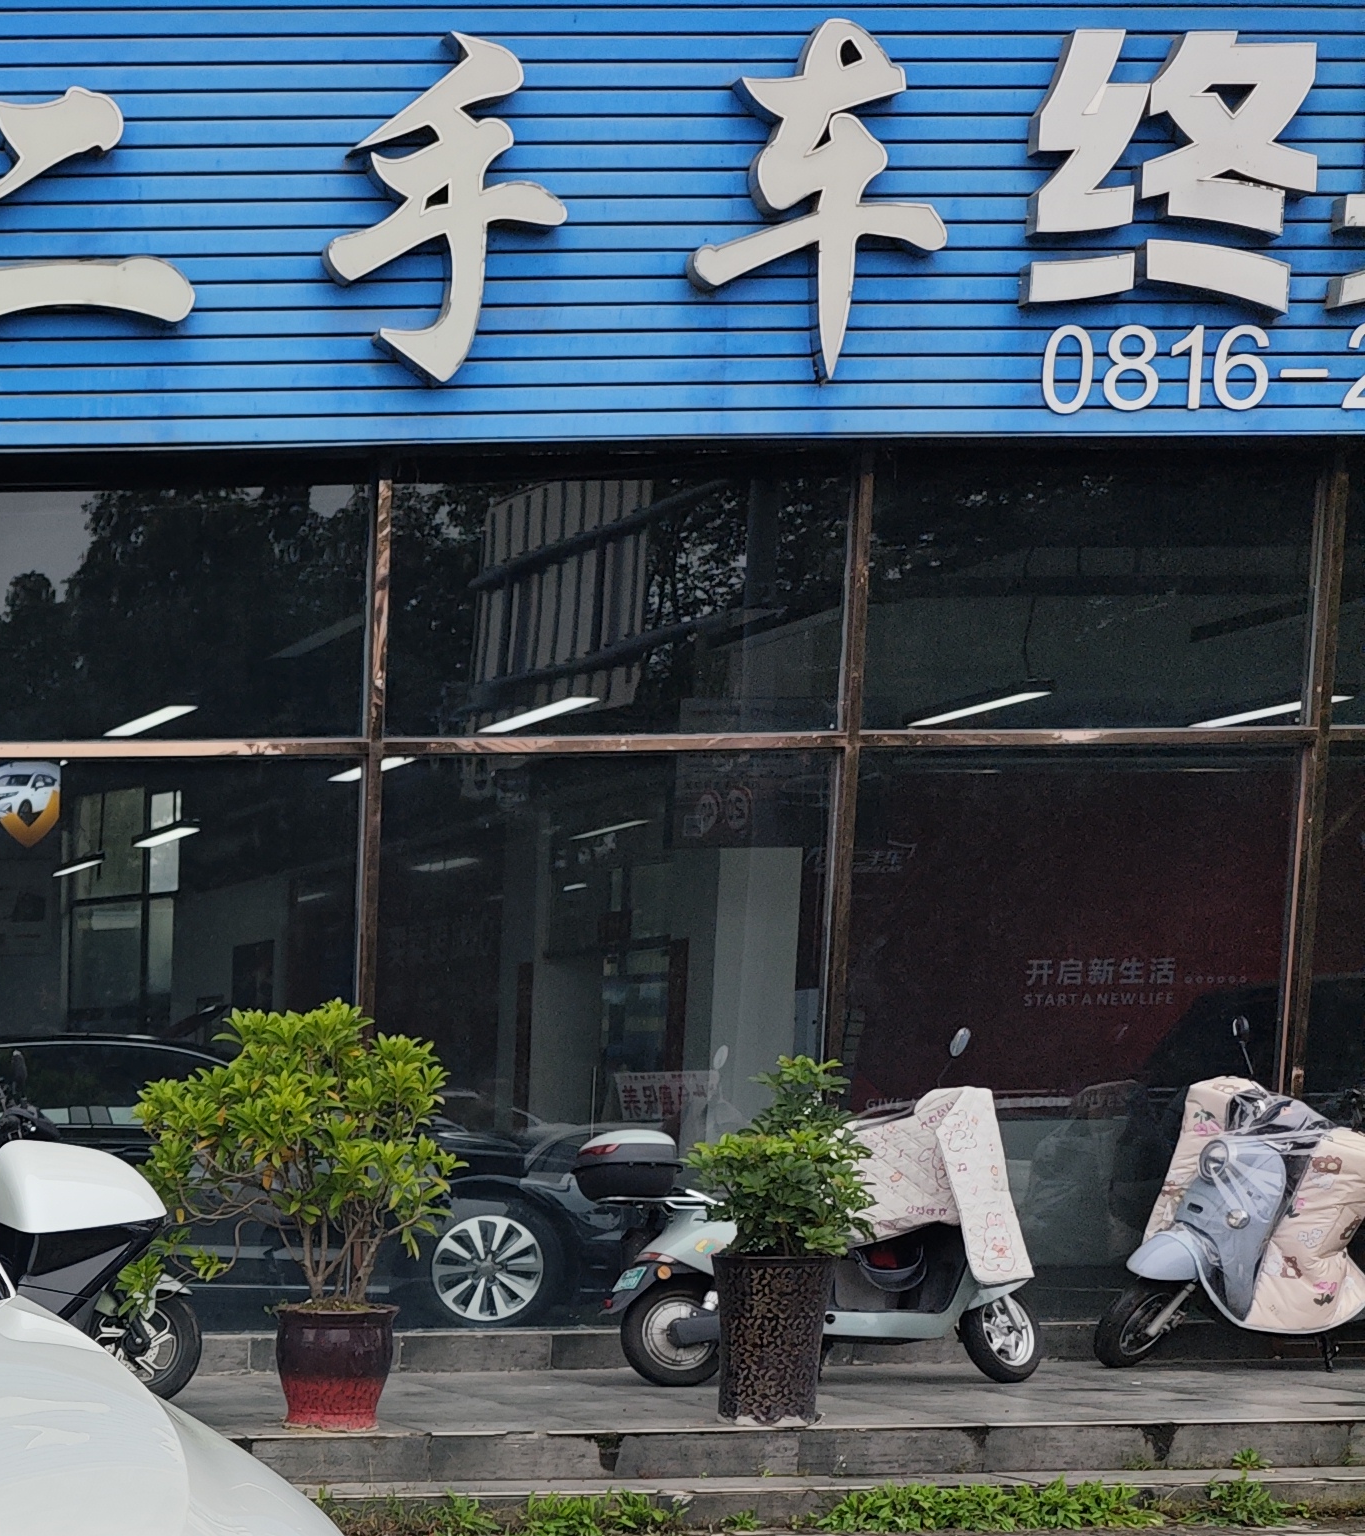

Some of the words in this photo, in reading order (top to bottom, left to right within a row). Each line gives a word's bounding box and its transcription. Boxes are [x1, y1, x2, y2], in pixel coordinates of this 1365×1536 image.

[1023, 993, 1077, 1007] START
[1080, 993, 1092, 1006] A
[1096, 993, 1134, 1006] NEW
[1136, 992, 1174, 1005] LIFE
[1077, 1094, 1127, 1108] INVES
